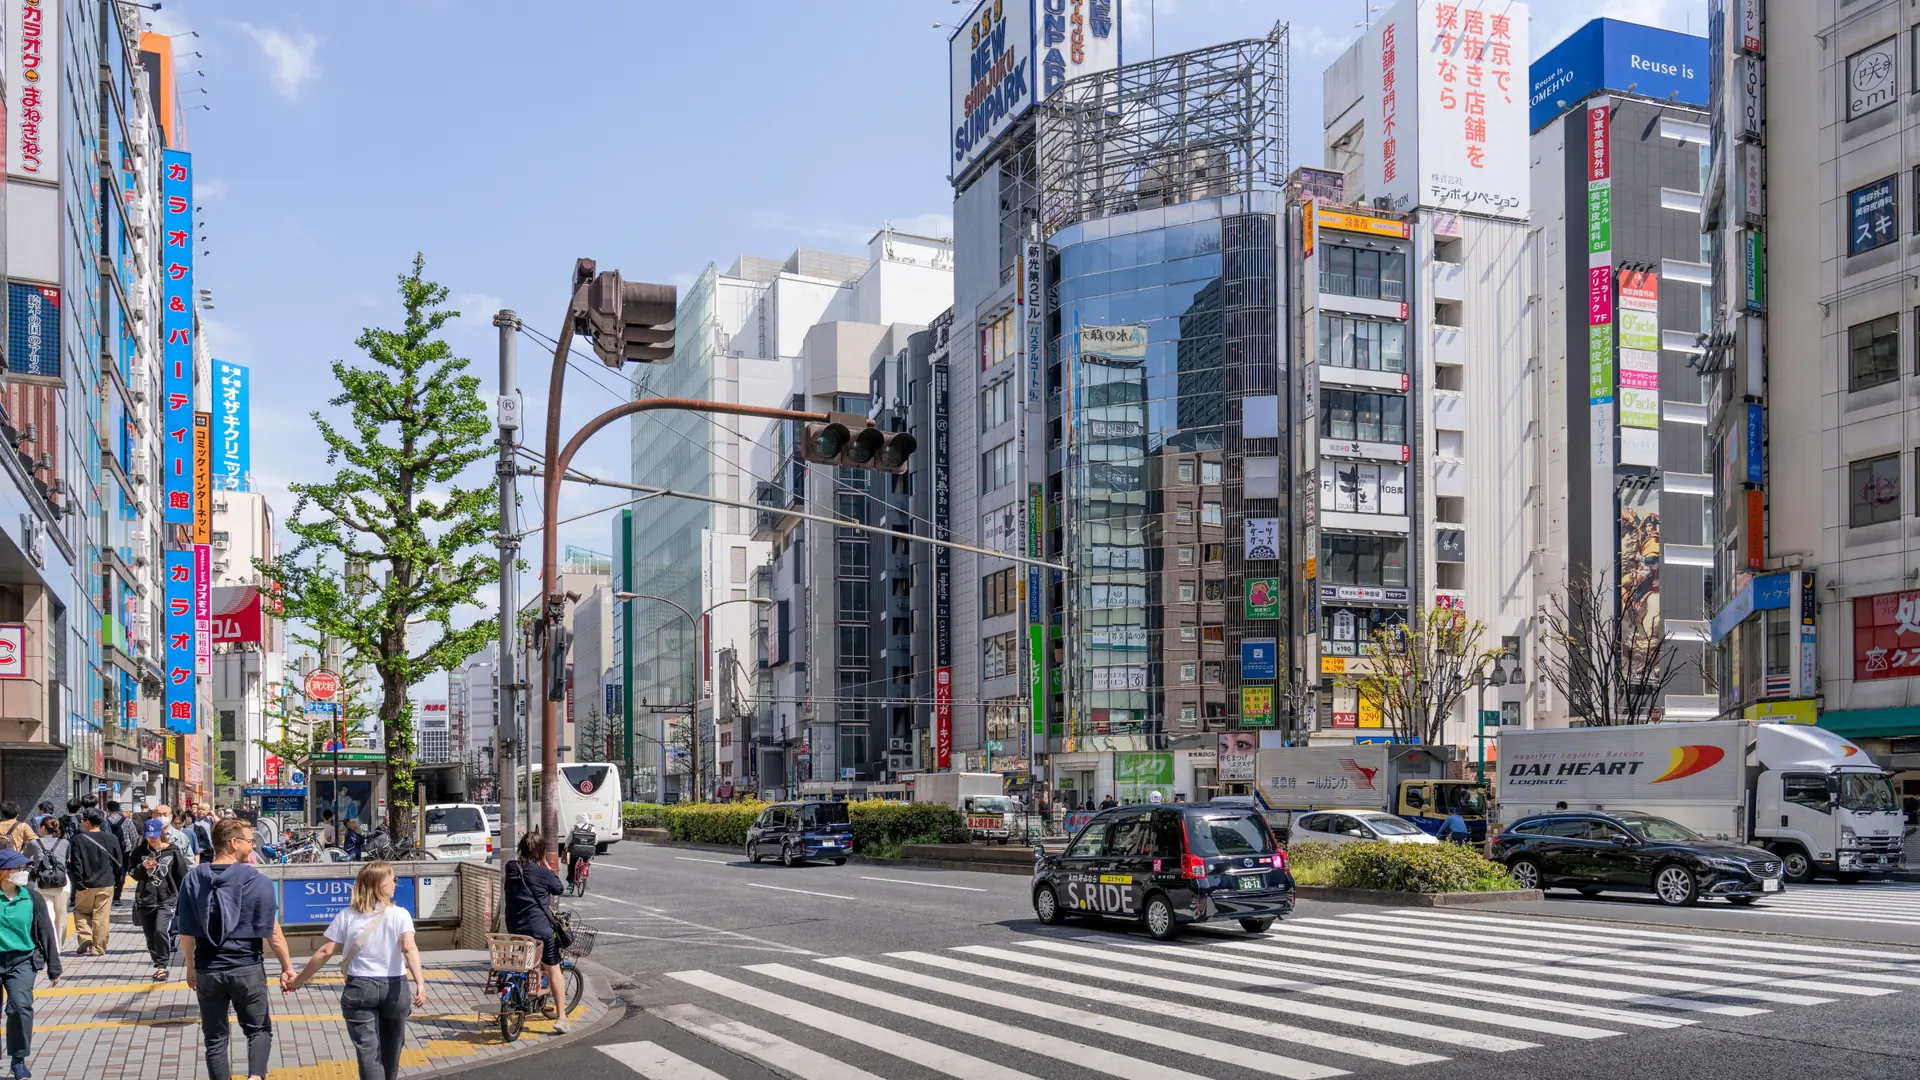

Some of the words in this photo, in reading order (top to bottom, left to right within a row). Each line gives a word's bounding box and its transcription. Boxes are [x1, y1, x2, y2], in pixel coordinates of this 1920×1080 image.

[21, 6, 43, 67] カラオケ
[970, 16, 1007, 89] NEW
[1435, 2, 1459, 111] 探すなら
[964, 44, 1015, 119] SHINJUKU
[1534, 72, 1556, 91] Reuse
[1556, 67, 1564, 76] is
[1631, 54, 1678, 76] Reuse
[1682, 65, 1695, 79] is
[955, 56, 1028, 162] SUNPARK
[1381, 24, 1397, 184] 店舗専門不動産
[1463, 9, 1487, 169] 居抜き店舗を
[1747, 59, 1758, 132] MOUTON
[1851, 80, 1895, 113] emi
[19, 86, 44, 175] まねきねこ
[1593, 119, 1605, 178] 東京美容外科
[1431, 184, 1520, 209] テンポイノベーション
[1591, 192, 1601, 241] 美容皮膚科
[1601, 190, 1609, 223] オラクル
[1855, 196, 1893, 218] 美容皮膚科
[1858, 186, 1889, 206] 美容外科
[1593, 241, 1606, 251] 8F
[1747, 236, 1756, 292] FamilyMart
[1028, 245, 1041, 320] 新光第2ビル
[1591, 269, 1600, 312] クリニック
[1601, 267, 1609, 303] フィラー
[1593, 313, 1607, 323] 7F
[1030, 326, 1040, 387] パステルコート
[1594, 386, 1608, 396] 6F
[222, 386, 241, 491] オザキクリニック
[196, 431, 206, 536] コミック・インターネット
[169, 564, 191, 719] カラオケ館
[198, 632, 207, 655] 化粧品
[312, 681, 336, 693] 消火栓
[939, 684, 949, 758] バーガーキング
[1119, 758, 1167, 777] レイク
[1509, 763, 1552, 777] DAI
[1558, 761, 1645, 776] HEART
[1513, 752, 1556, 760] Heartfelt
[1561, 752, 1601, 760] Logistic
[1509, 778, 1570, 787] Logistic
[1068, 882, 1135, 914] S.RIDE
